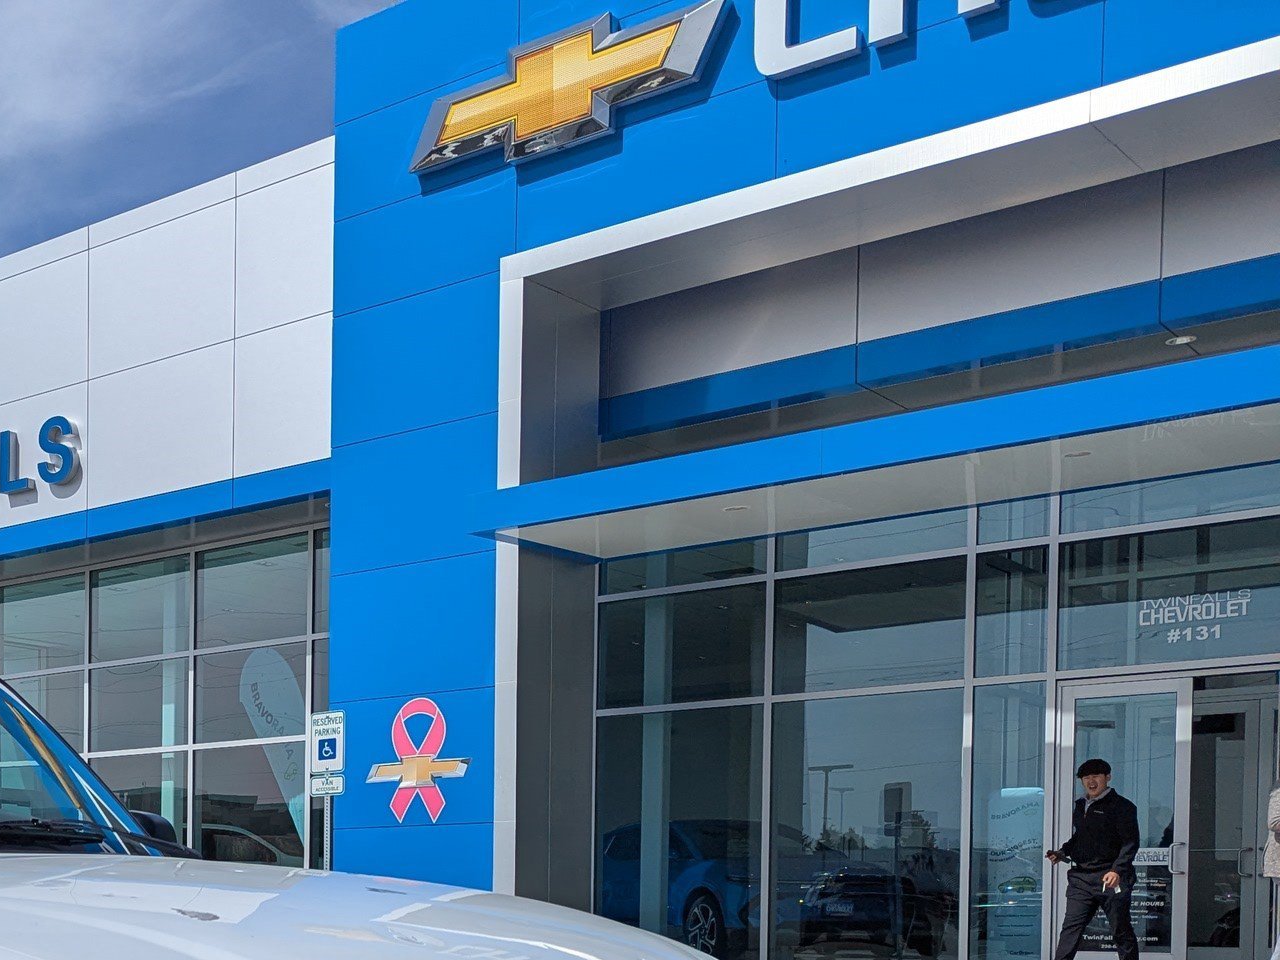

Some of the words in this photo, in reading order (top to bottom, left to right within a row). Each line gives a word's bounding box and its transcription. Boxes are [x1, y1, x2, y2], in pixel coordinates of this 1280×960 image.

[1139, 598, 1251, 626] CHEVROLET
[1167, 624, 1221, 644] #131
[250, 682, 295, 760] BRAVORAA
[313, 715, 343, 728] RESERVED
[314, 726, 341, 737] PARKING
